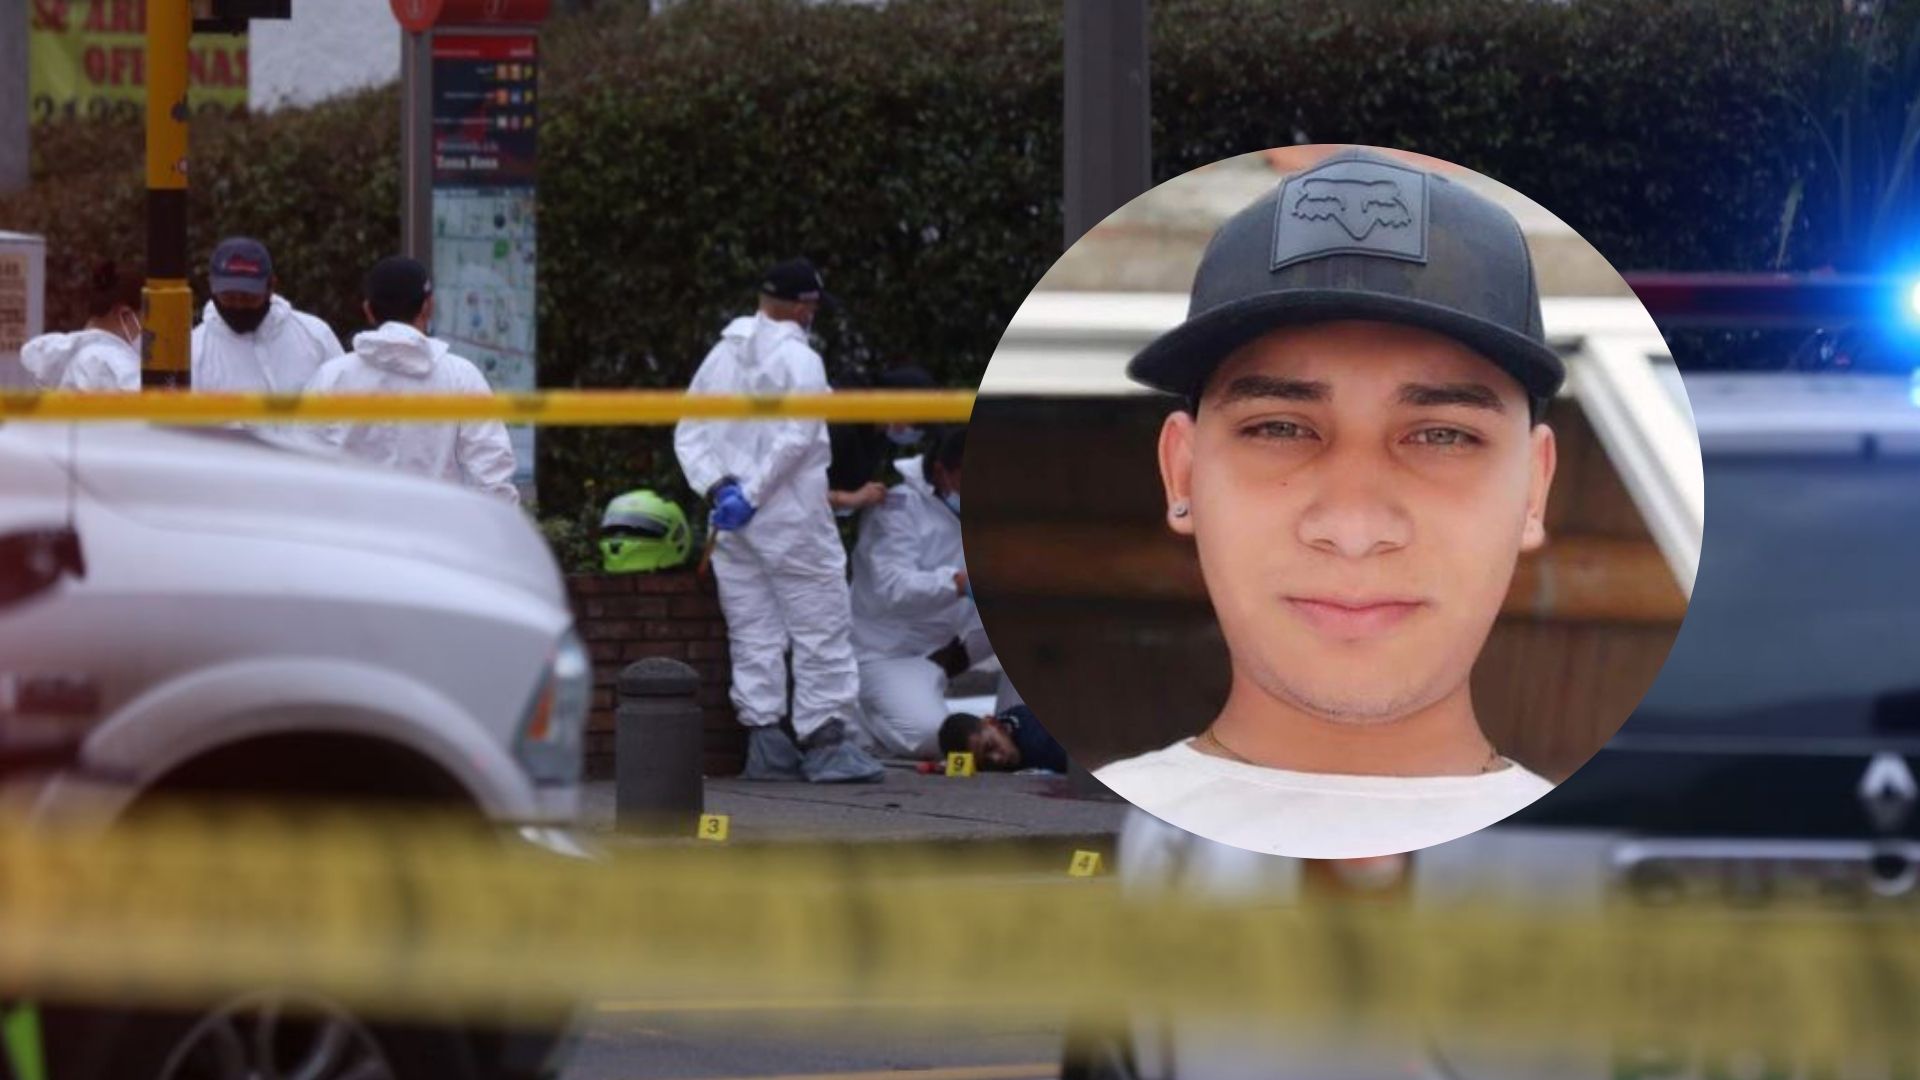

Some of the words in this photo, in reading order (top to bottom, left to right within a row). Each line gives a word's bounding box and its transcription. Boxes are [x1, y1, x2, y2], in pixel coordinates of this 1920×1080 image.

[953, 755, 966, 771] 9
[707, 818, 720, 834] 3
[1077, 854, 1091, 871] 4
